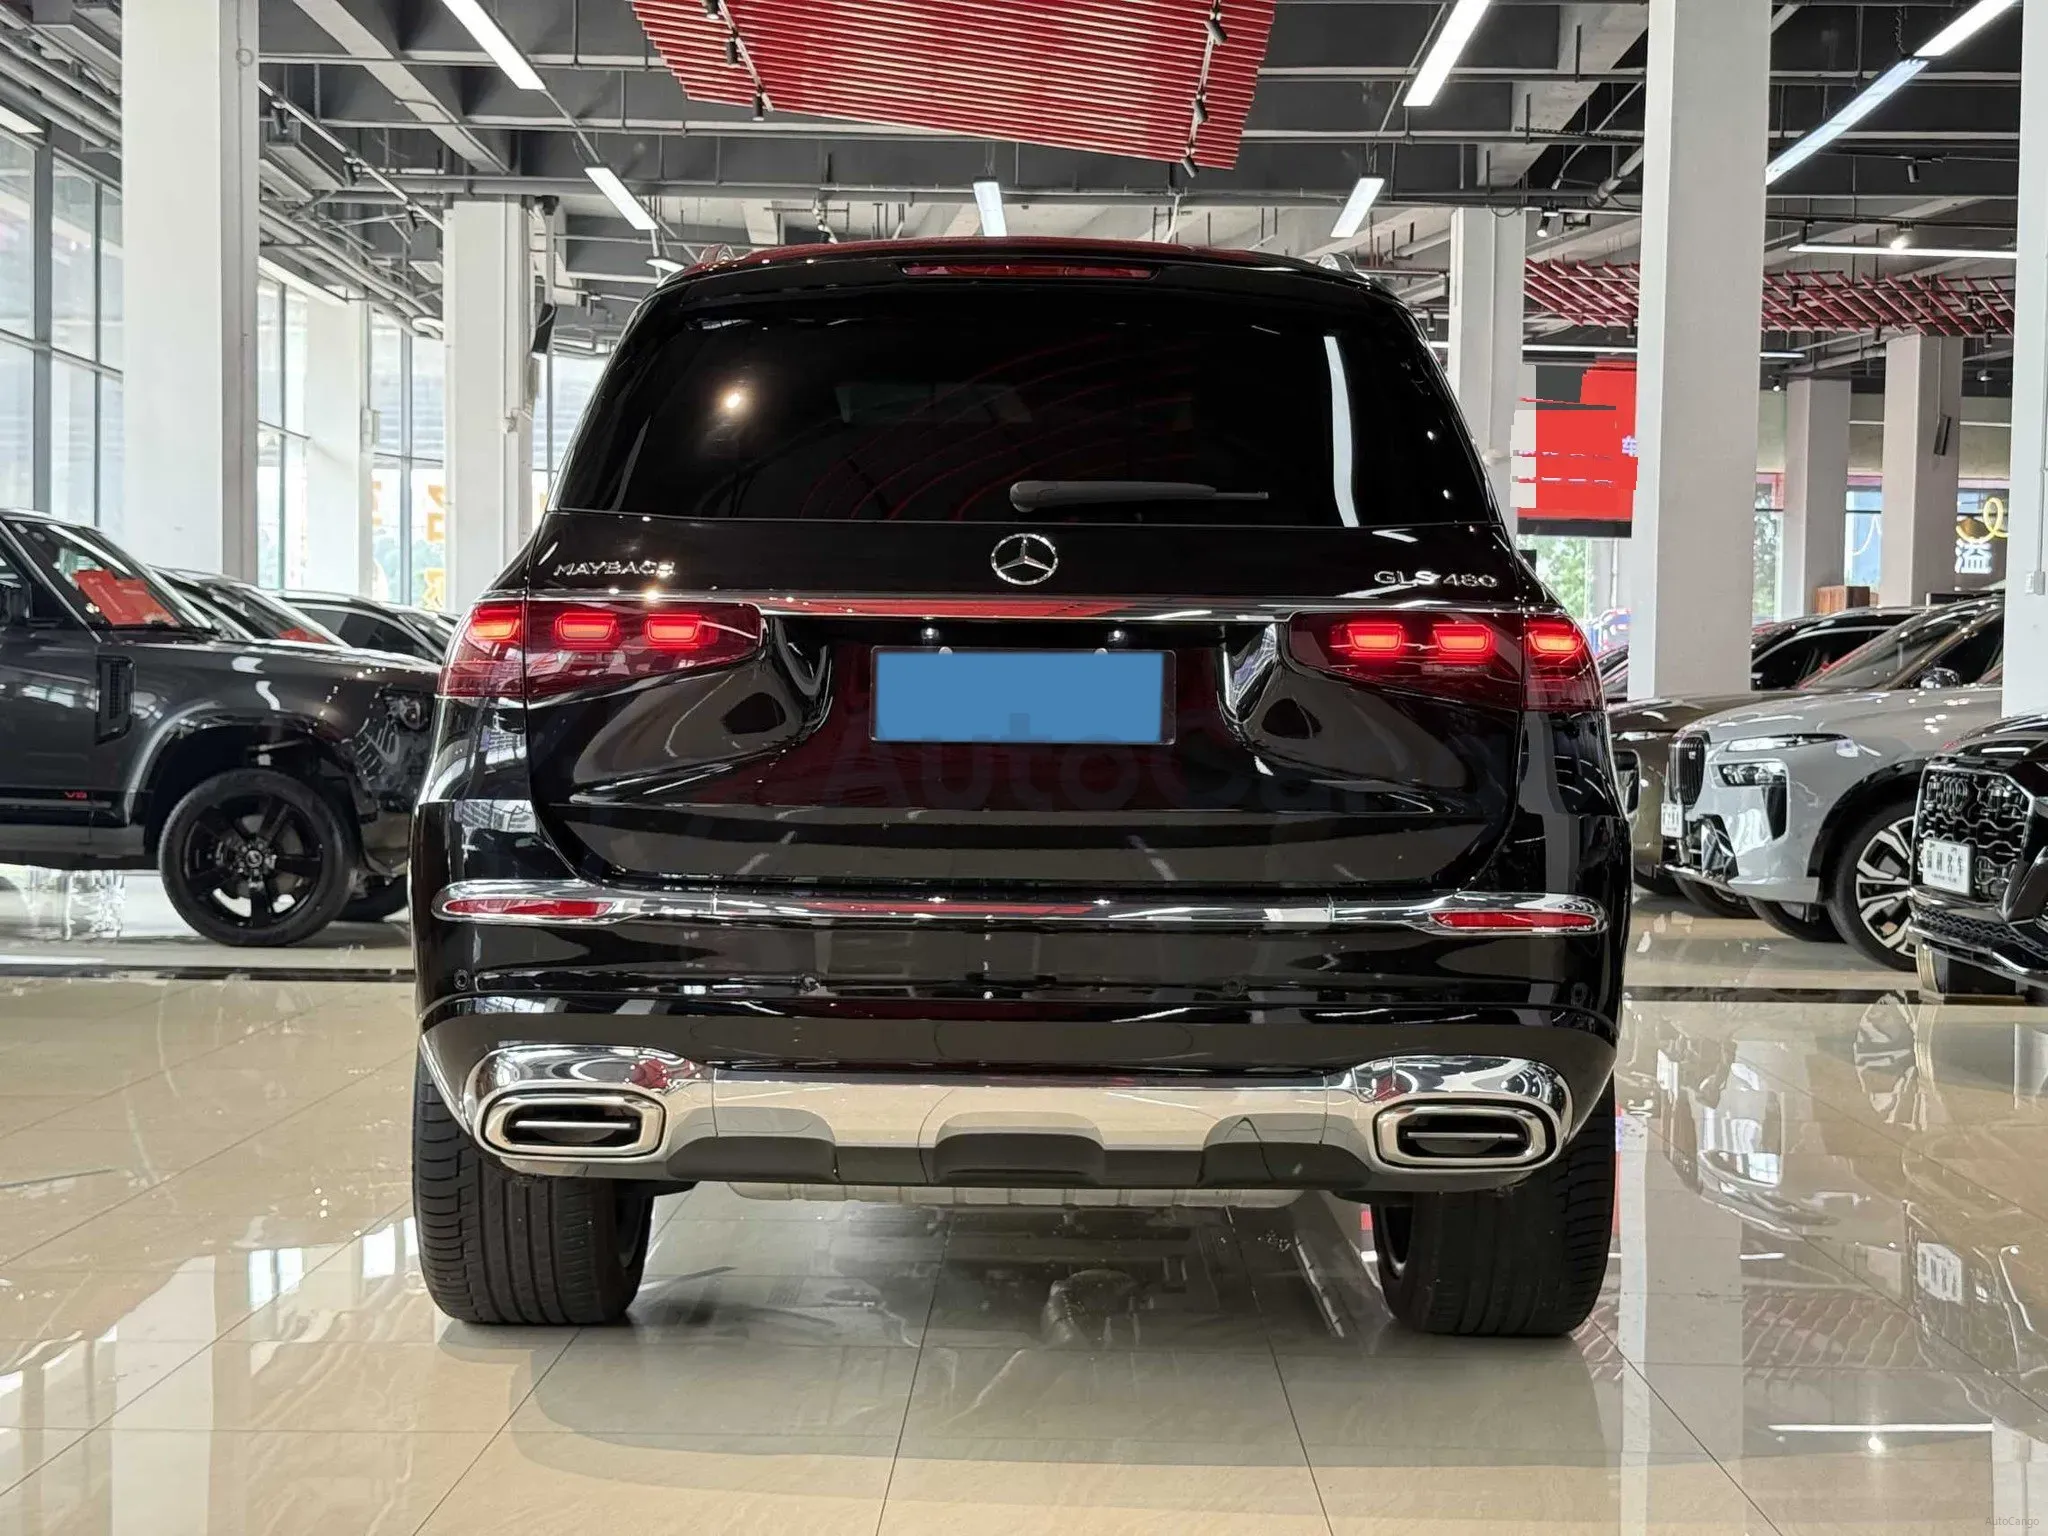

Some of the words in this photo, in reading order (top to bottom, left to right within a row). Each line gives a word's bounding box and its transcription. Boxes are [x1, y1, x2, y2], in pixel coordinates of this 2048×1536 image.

[553, 560, 675, 577] MAYBACH
[1374, 570, 1440, 585] GLS
[1443, 573, 1498, 587] 480
